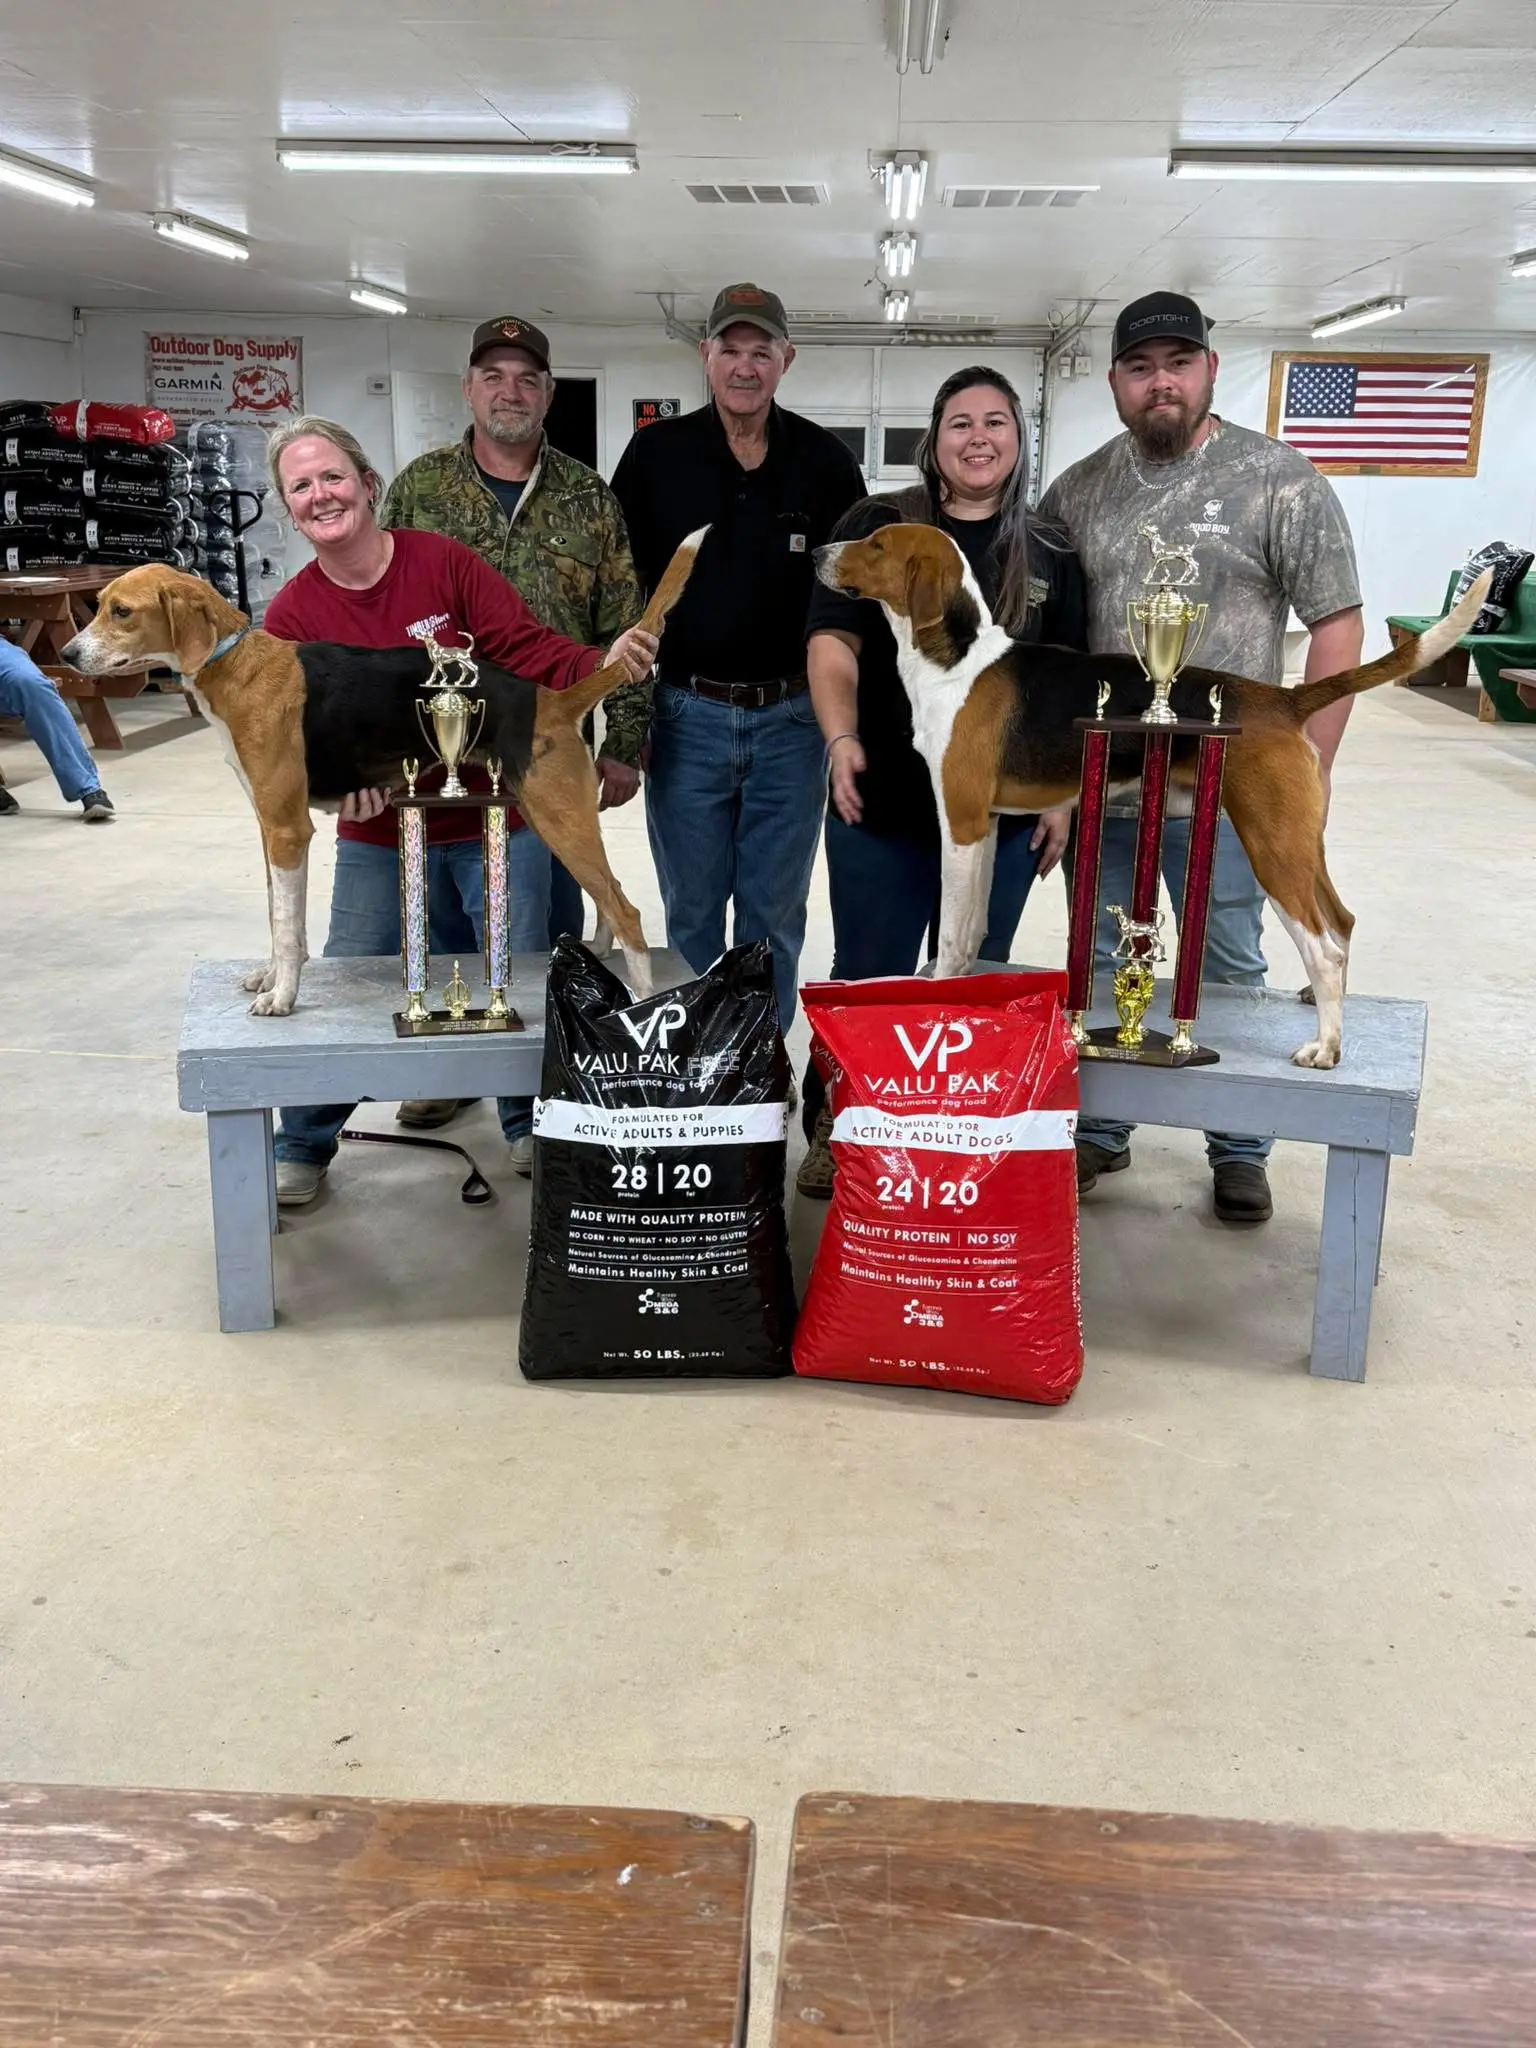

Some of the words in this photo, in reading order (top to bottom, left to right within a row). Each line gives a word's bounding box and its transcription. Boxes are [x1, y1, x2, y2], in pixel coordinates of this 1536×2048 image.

[151, 337, 210, 355] Outdoor
[214, 338, 244, 360] Dog
[247, 340, 297, 360] Supply
[155, 377, 223, 390] GARMIN
[643, 403, 655, 416] NO
[1211, 524, 1230, 535] BOY
[618, 1004, 687, 1050] VP
[893, 1022, 973, 1073] VP
[573, 1052, 628, 1075] VALU
[638, 1052, 681, 1076] PAK
[602, 1079, 663, 1091] performance
[666, 1080, 686, 1092] dog
[689, 1078, 715, 1089] food
[864, 1074, 936, 1096] VALU
[947, 1070, 1001, 1095] PAK
[877, 1098, 937, 1108] performance
[941, 1097, 961, 1109] dog
[963, 1096, 987, 1106] food
[612, 1114, 678, 1124] FORMULATED
[683, 1113, 704, 1122] FOR
[883, 1116, 954, 1130] FORMULATD
[959, 1122, 980, 1132] FOR
[574, 1123, 617, 1139] ACTIVE
[623, 1127, 673, 1140] ADULTS
[678, 1126, 687, 1138] &
[693, 1125, 744, 1137] PUPPIES
[852, 1125, 904, 1140] ACTIVE
[911, 1130, 964, 1147] ADULT
[969, 1132, 1013, 1148] DOGS
[611, 1163, 648, 1190] 28
[673, 1163, 712, 1190] 20
[617, 1191, 640, 1199] protein
[876, 1176, 913, 1203] 24
[939, 1181, 979, 1206] 20
[570, 1208, 603, 1222] MADE
[606, 1212, 636, 1225] WITH
[641, 1213, 694, 1226] QUALITY
[699, 1210, 747, 1224] PROTEIN
[569, 1231, 581, 1239] NO
[582, 1232, 605, 1241] CORN
[612, 1235, 626, 1243] NO
[628, 1236, 656, 1244] WHEAT
[665, 1236, 678, 1244] NO
[681, 1235, 697, 1244] SOY
[720, 1230, 748, 1241] GLUTEN
[843, 1220, 890, 1239] QUALITY
[894, 1229, 950, 1244] PROTEIN
[967, 1233, 989, 1244] NO
[992, 1233, 1017, 1244] SOY
[568, 1248, 596, 1258] Natural
[598, 1251, 628, 1260] Sources
[642, 1253, 695, 1261] Glucosamine
[868, 1248, 895, 1259] Sources
[897, 1253, 905, 1261] of
[908, 1254, 961, 1264] Glucosamine
[972, 1257, 1017, 1265] Chondroitin
[568, 1262, 625, 1277] Maintains
[629, 1267, 677, 1280] Healthy
[681, 1266, 706, 1278] Skin
[711, 1265, 719, 1275] &
[724, 1261, 748, 1273] Coat
[841, 1261, 892, 1282] Maintains
[896, 1273, 942, 1289] Healthy
[947, 1277, 973, 1288] Skin
[977, 1278, 985, 1289] &
[989, 1275, 1019, 1288] Coat
[911, 1312, 944, 1321] OMEGA
[633, 1350, 652, 1359] 50
[657, 1350, 685, 1359] LBS.
[899, 1358, 917, 1367] 50
[921, 1360, 951, 1371] LBS.
